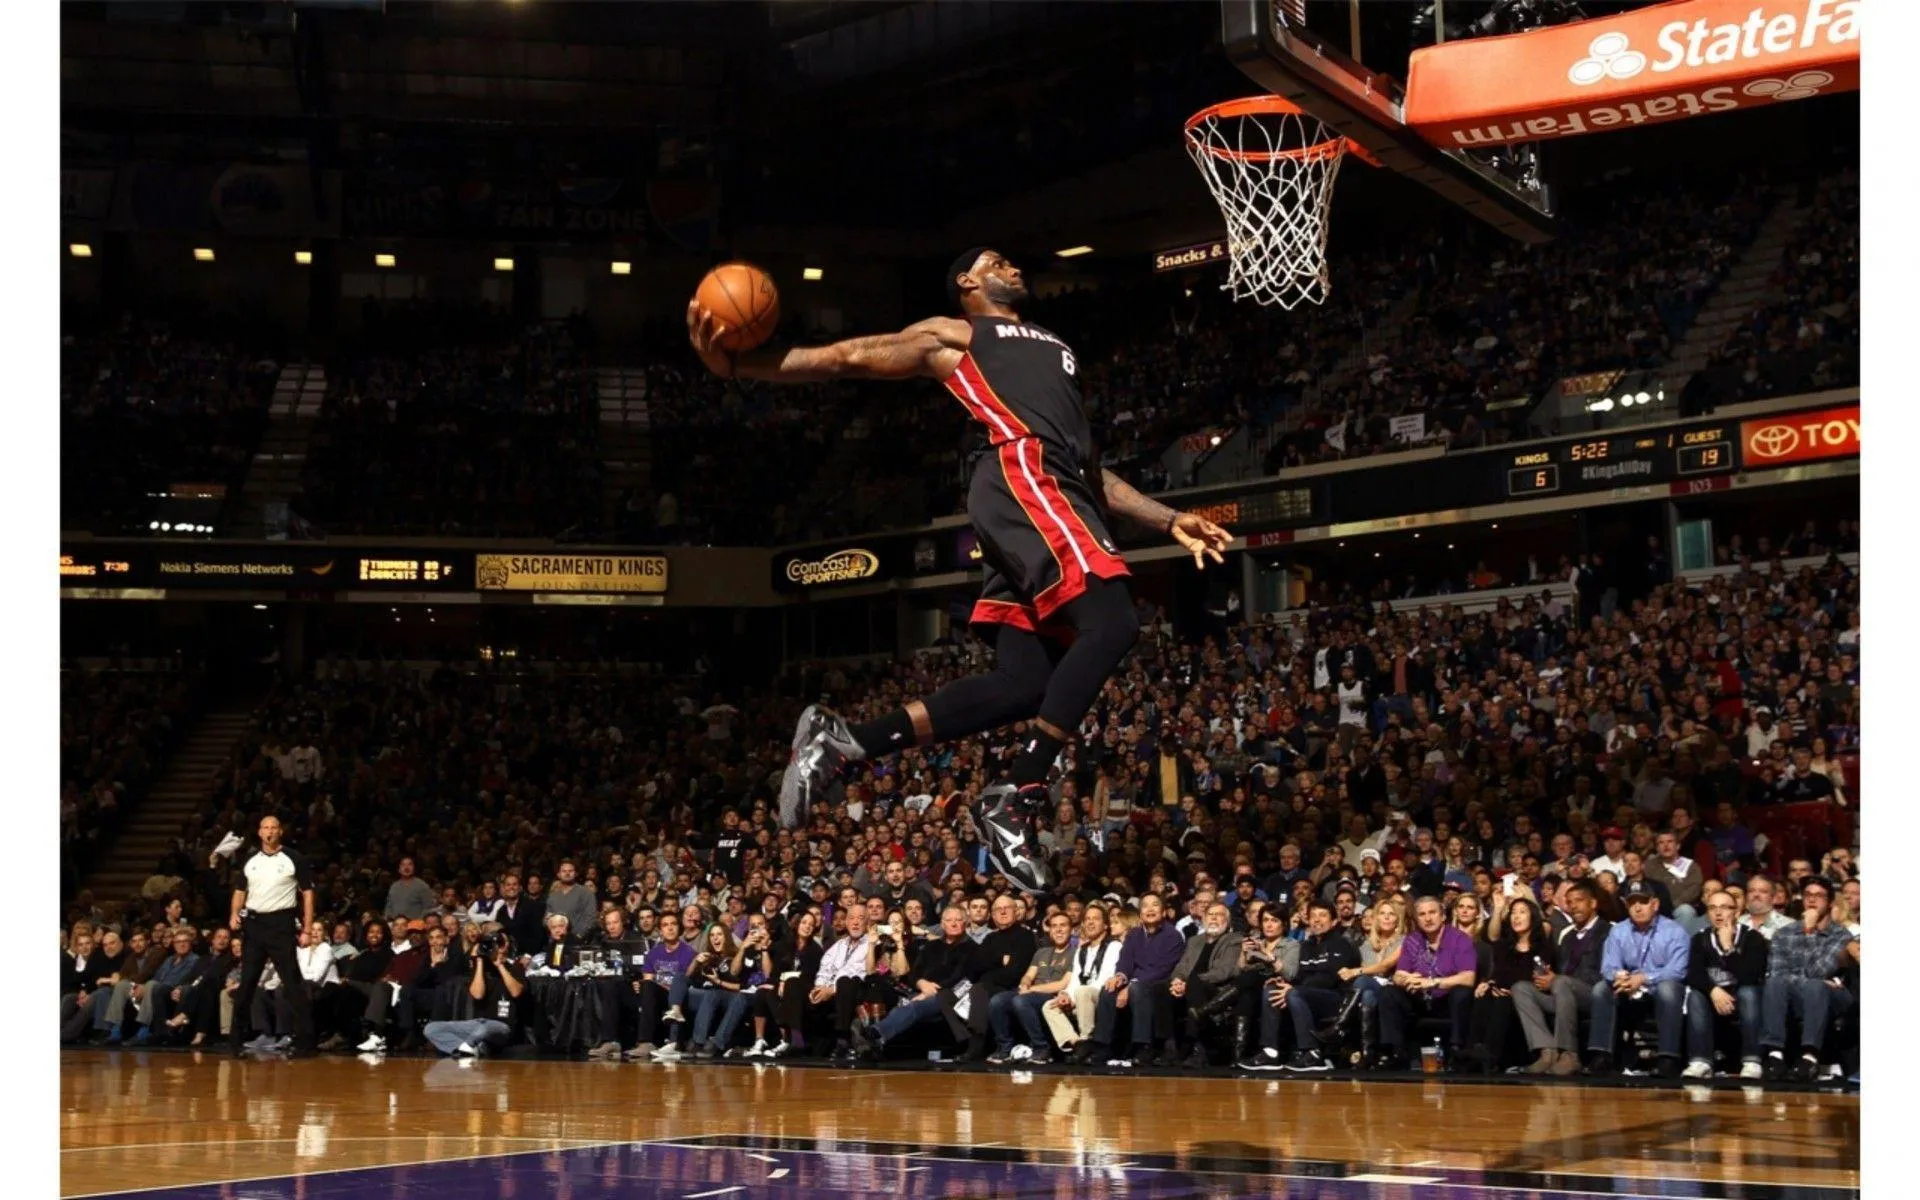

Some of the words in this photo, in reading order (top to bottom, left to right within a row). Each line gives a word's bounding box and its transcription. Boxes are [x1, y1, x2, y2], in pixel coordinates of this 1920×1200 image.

[564, 207, 648, 231] ZONE
[1156, 249, 1207, 269] Snacks
[1211, 244, 1223, 258] &
[1061, 350, 1075, 376] 6
[1683, 428, 1723, 444] GUEST
[1515, 452, 1549, 466] KINGS
[1571, 441, 1608, 461] 5:22
[1702, 448, 1719, 466] 19
[1536, 471, 1546, 487] 6
[1689, 477, 1713, 494] 103
[160, 562, 191, 573] Nokia
[194, 561, 240, 575] Siemens
[242, 563, 294, 575] Networks
[511, 557, 613, 576] SACRAMENTO
[618, 558, 664, 577] KINGS
